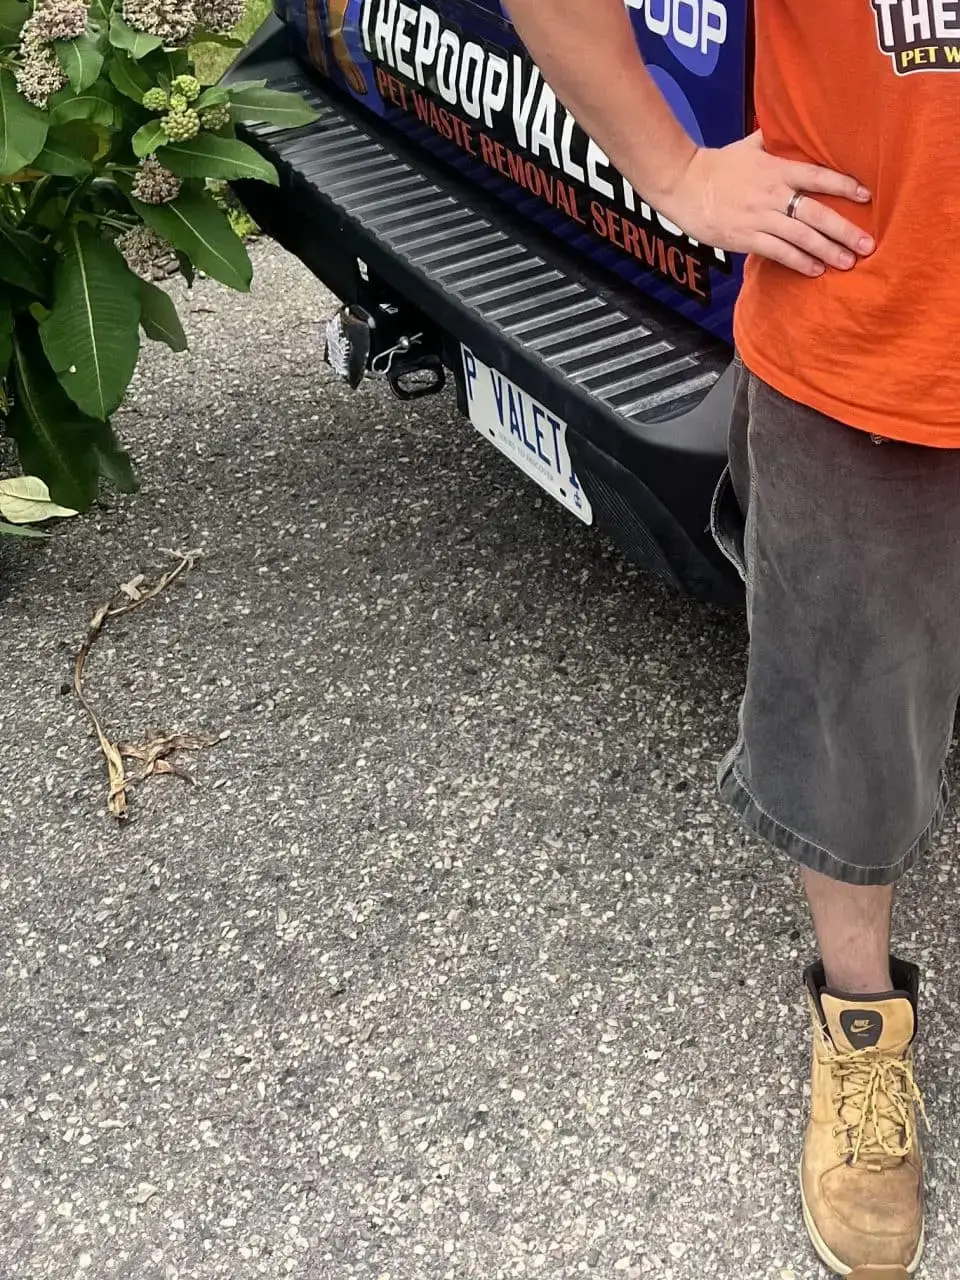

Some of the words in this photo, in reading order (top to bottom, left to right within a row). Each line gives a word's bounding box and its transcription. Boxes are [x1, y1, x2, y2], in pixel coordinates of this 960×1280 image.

[901, 46, 938, 68] PET
[376, 66, 408, 112] PET
[411, 88, 477, 157] WASTE
[479, 132, 587, 226] REMOVAL
[590, 200, 706, 298] SERVICE
[489, 368, 562, 475] VALET
